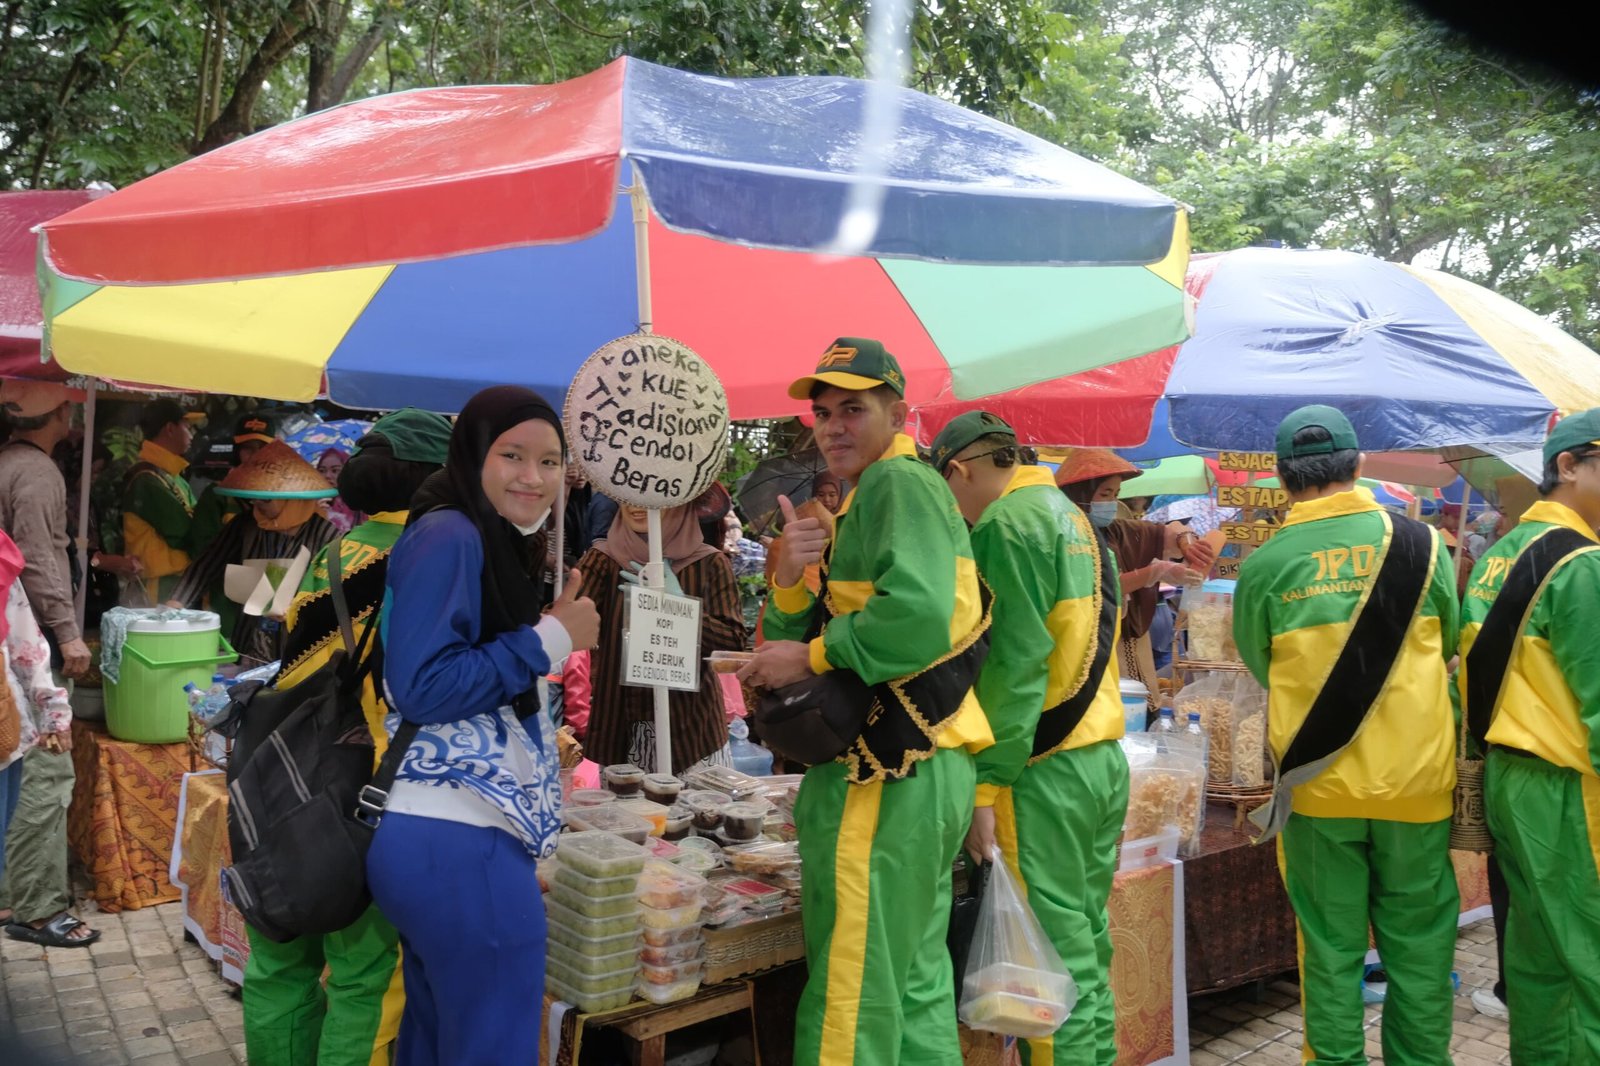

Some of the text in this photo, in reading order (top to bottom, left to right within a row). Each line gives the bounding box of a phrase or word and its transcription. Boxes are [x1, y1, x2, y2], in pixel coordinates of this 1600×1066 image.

[622, 345, 700, 376] aneka
[642, 370, 689, 400] KUE
[608, 428, 693, 462] Cendol
[610, 456, 682, 498] Beras
[1222, 526, 1250, 540] ES
[1311, 544, 1376, 581] JPD
[638, 593, 659, 612] SEDIA
[656, 618, 674, 630] KOPI
[650, 633, 678, 648] ES TEH
[642, 651, 685, 668] ES JERUK
[632, 665, 641, 678] ES
